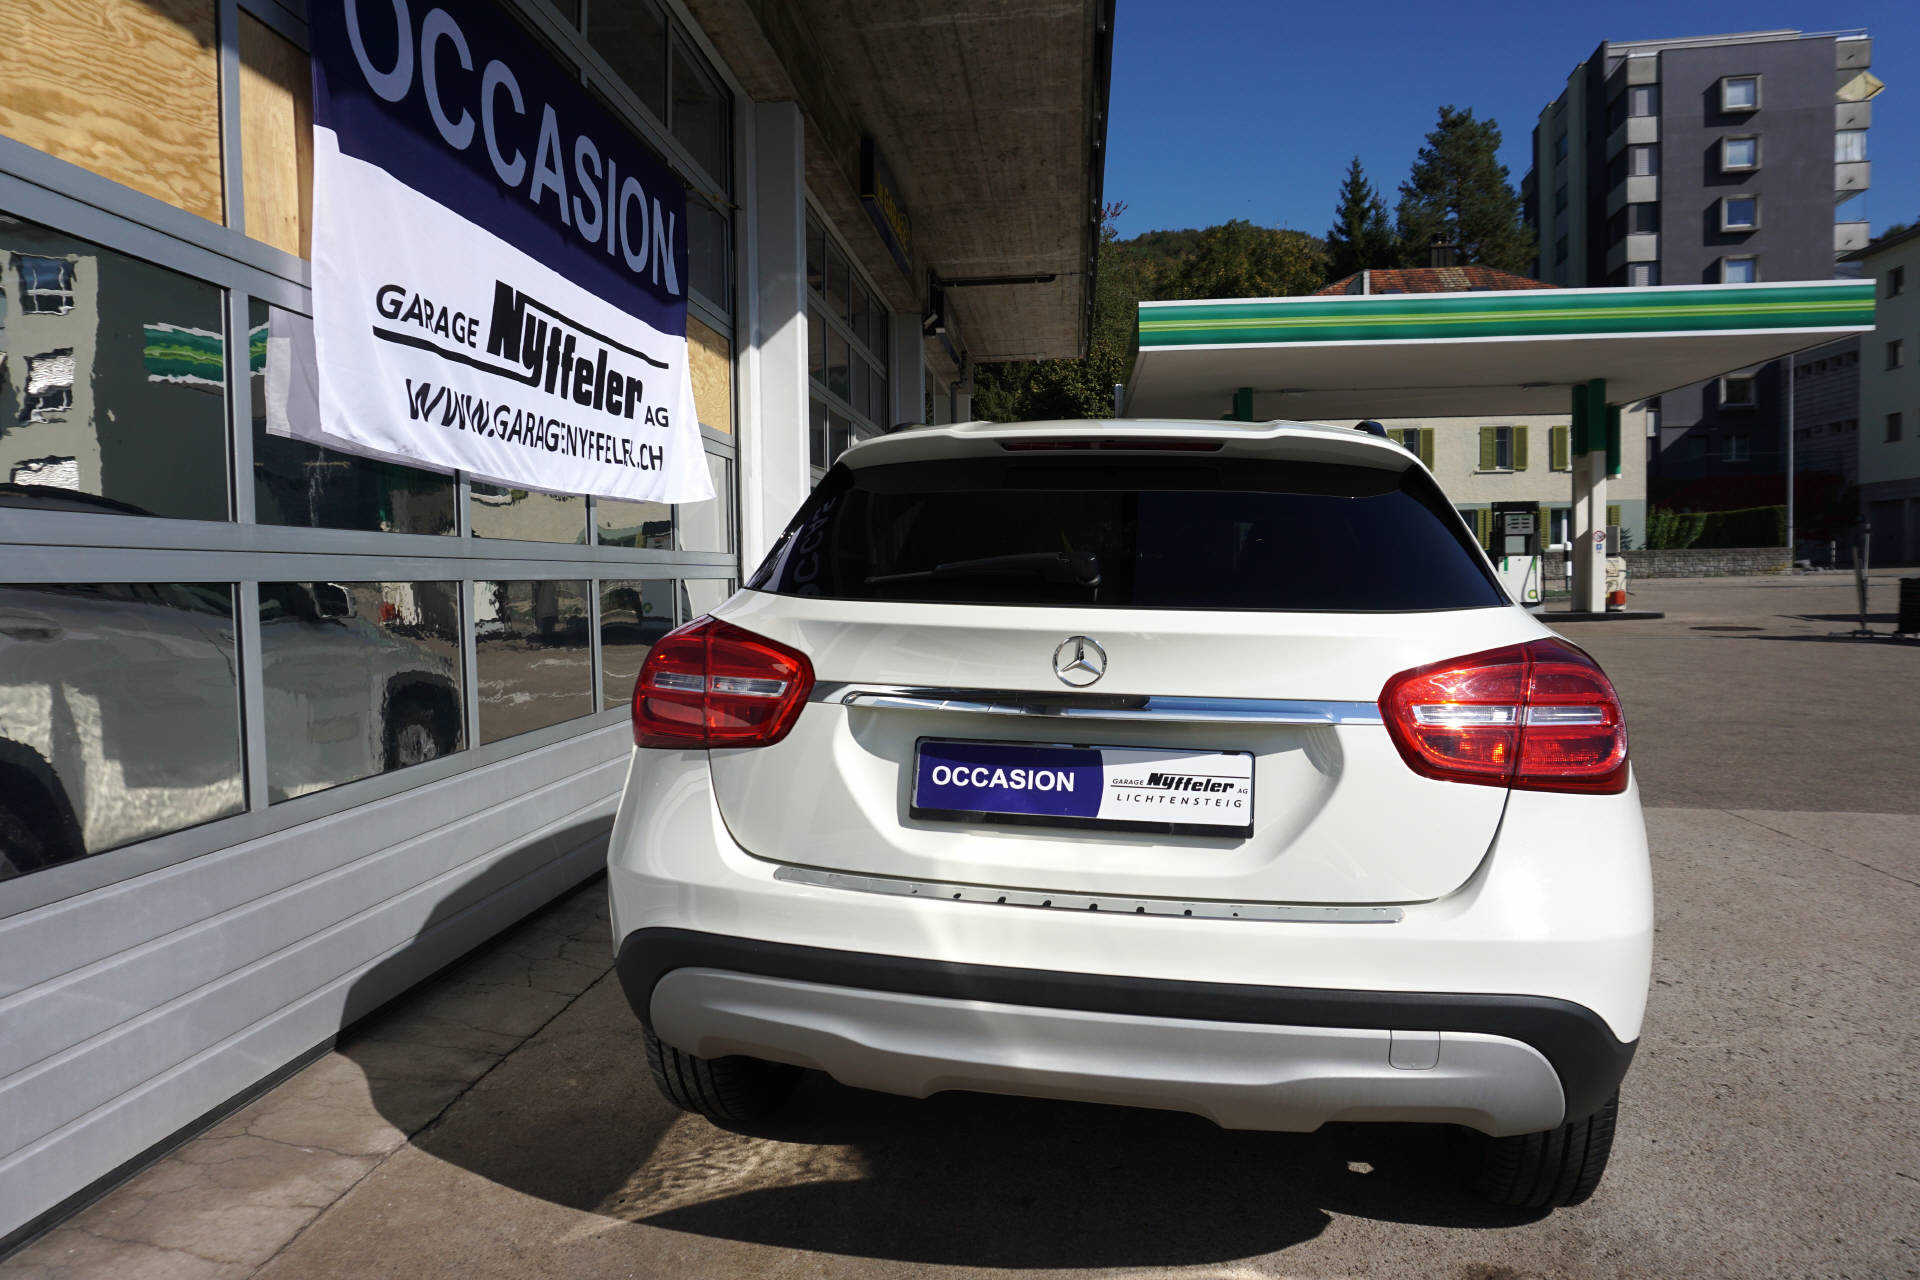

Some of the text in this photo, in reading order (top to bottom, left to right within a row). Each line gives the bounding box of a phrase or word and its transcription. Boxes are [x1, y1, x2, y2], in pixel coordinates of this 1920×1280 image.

[344, 0, 680, 295] OCCASION
[375, 280, 669, 427] GARAGE Nyffeler AG
[932, 765, 1075, 792] OCCASION
[1112, 772, 1248, 795] GARAGE Nyffeler AG
[1116, 793, 1242, 808] LICHTENSTEIG
